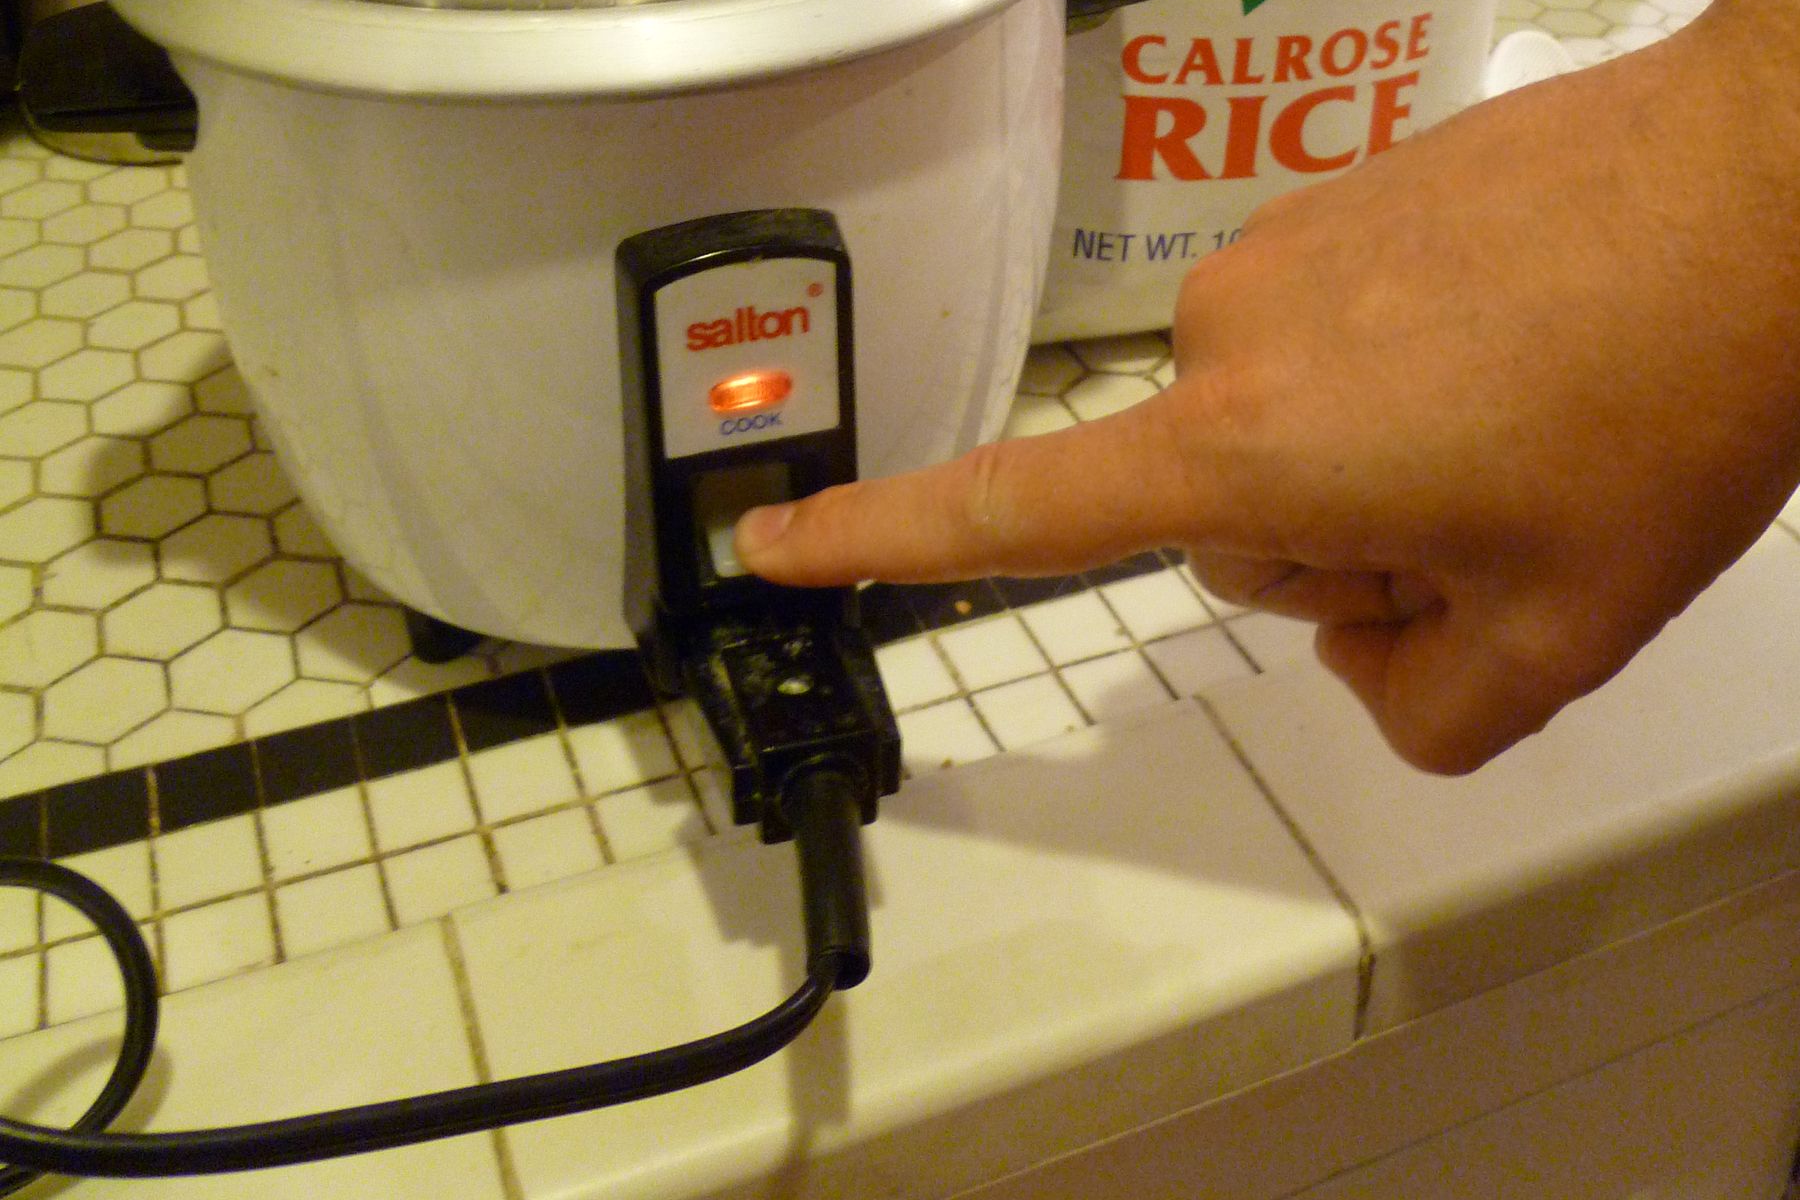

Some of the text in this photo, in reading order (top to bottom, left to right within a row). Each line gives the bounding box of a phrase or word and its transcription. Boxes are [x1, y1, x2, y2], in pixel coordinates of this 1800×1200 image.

[1120, 11, 1434, 86] CALROSE
[1114, 71, 1421, 182] RICE
[1072, 227, 1137, 262] NET
[1146, 231, 1198, 262] WT.
[686, 304, 811, 353] salton
[719, 411, 784, 437] COOK
